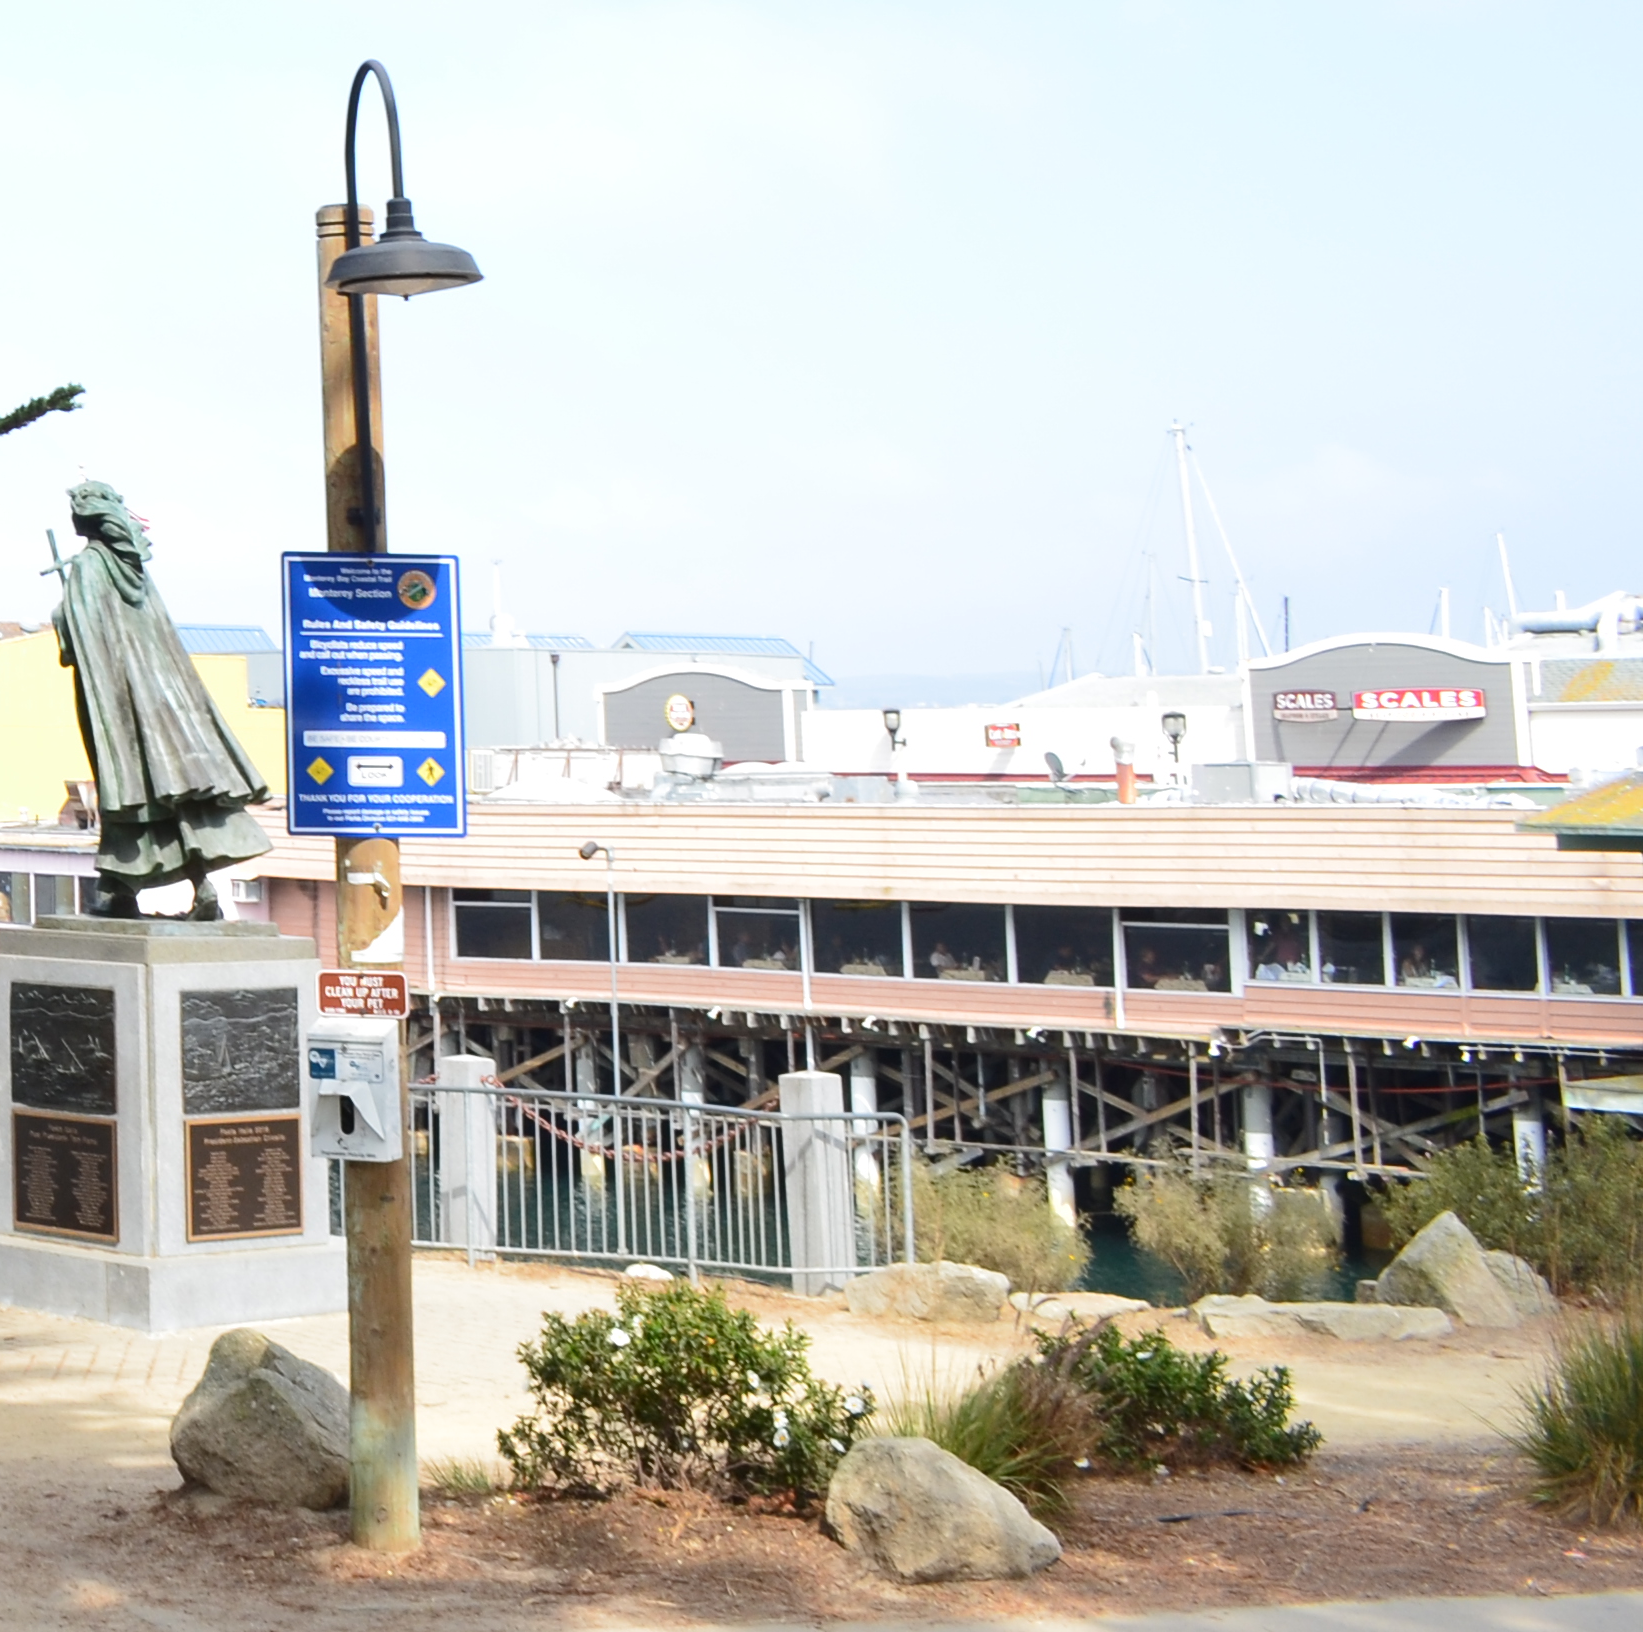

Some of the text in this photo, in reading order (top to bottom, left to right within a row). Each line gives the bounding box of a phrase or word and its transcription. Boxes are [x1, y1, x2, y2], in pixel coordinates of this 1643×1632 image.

[308, 587, 393, 600] Monterey Section
[303, 620, 440, 631] Rules And Safety Guidelines
[1275, 693, 1334, 710] SCALES
[1361, 690, 1477, 708] SCALES
[299, 794, 327, 802] THANK
[329, 794, 346, 802] YOU
[347, 794, 366, 803] FOR
[367, 794, 391, 803] YOUR
[338, 975, 384, 987] YOU MUST
[325, 986, 399, 999] CLEAN UP AFTER
[340, 998, 384, 1008] YOUR PET
